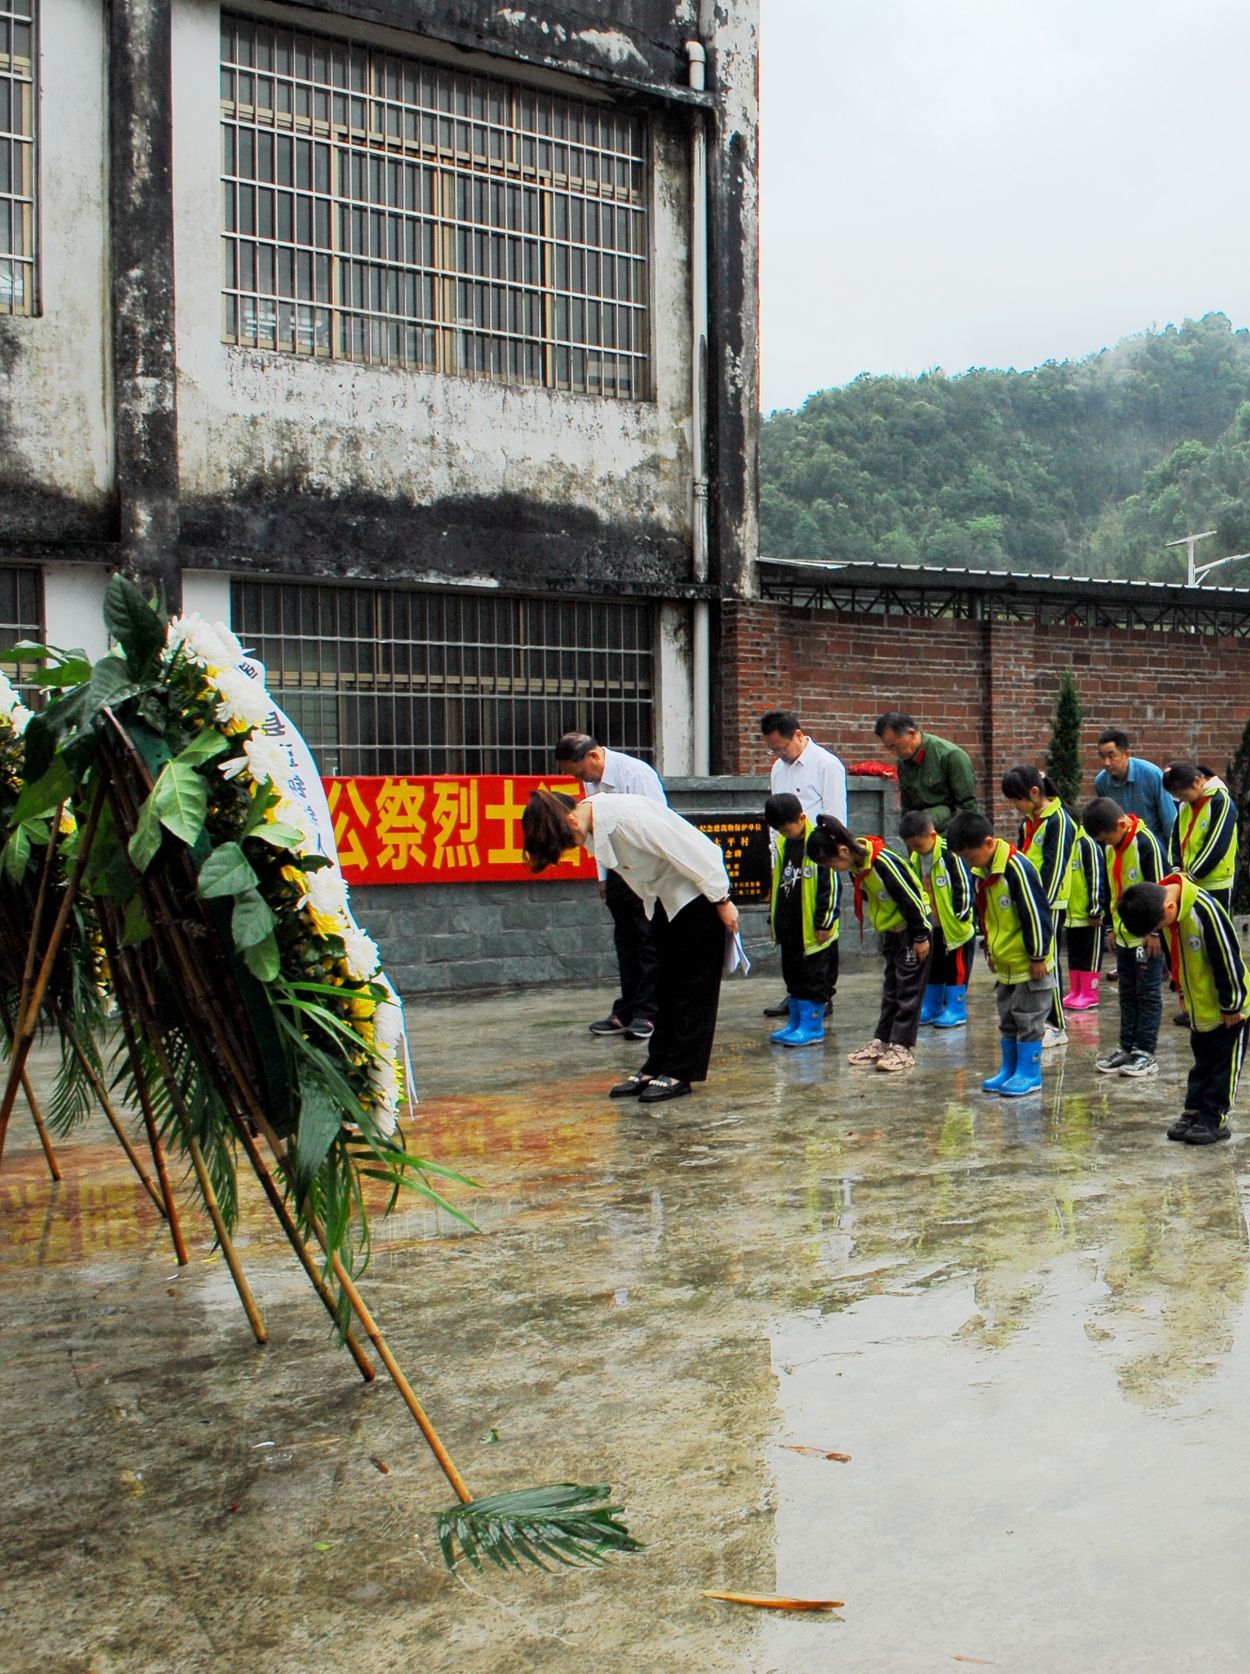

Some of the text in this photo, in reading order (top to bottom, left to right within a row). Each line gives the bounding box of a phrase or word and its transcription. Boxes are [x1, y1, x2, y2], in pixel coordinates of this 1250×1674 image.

[697, 823, 762, 832] 纪念建筑物保护单位
